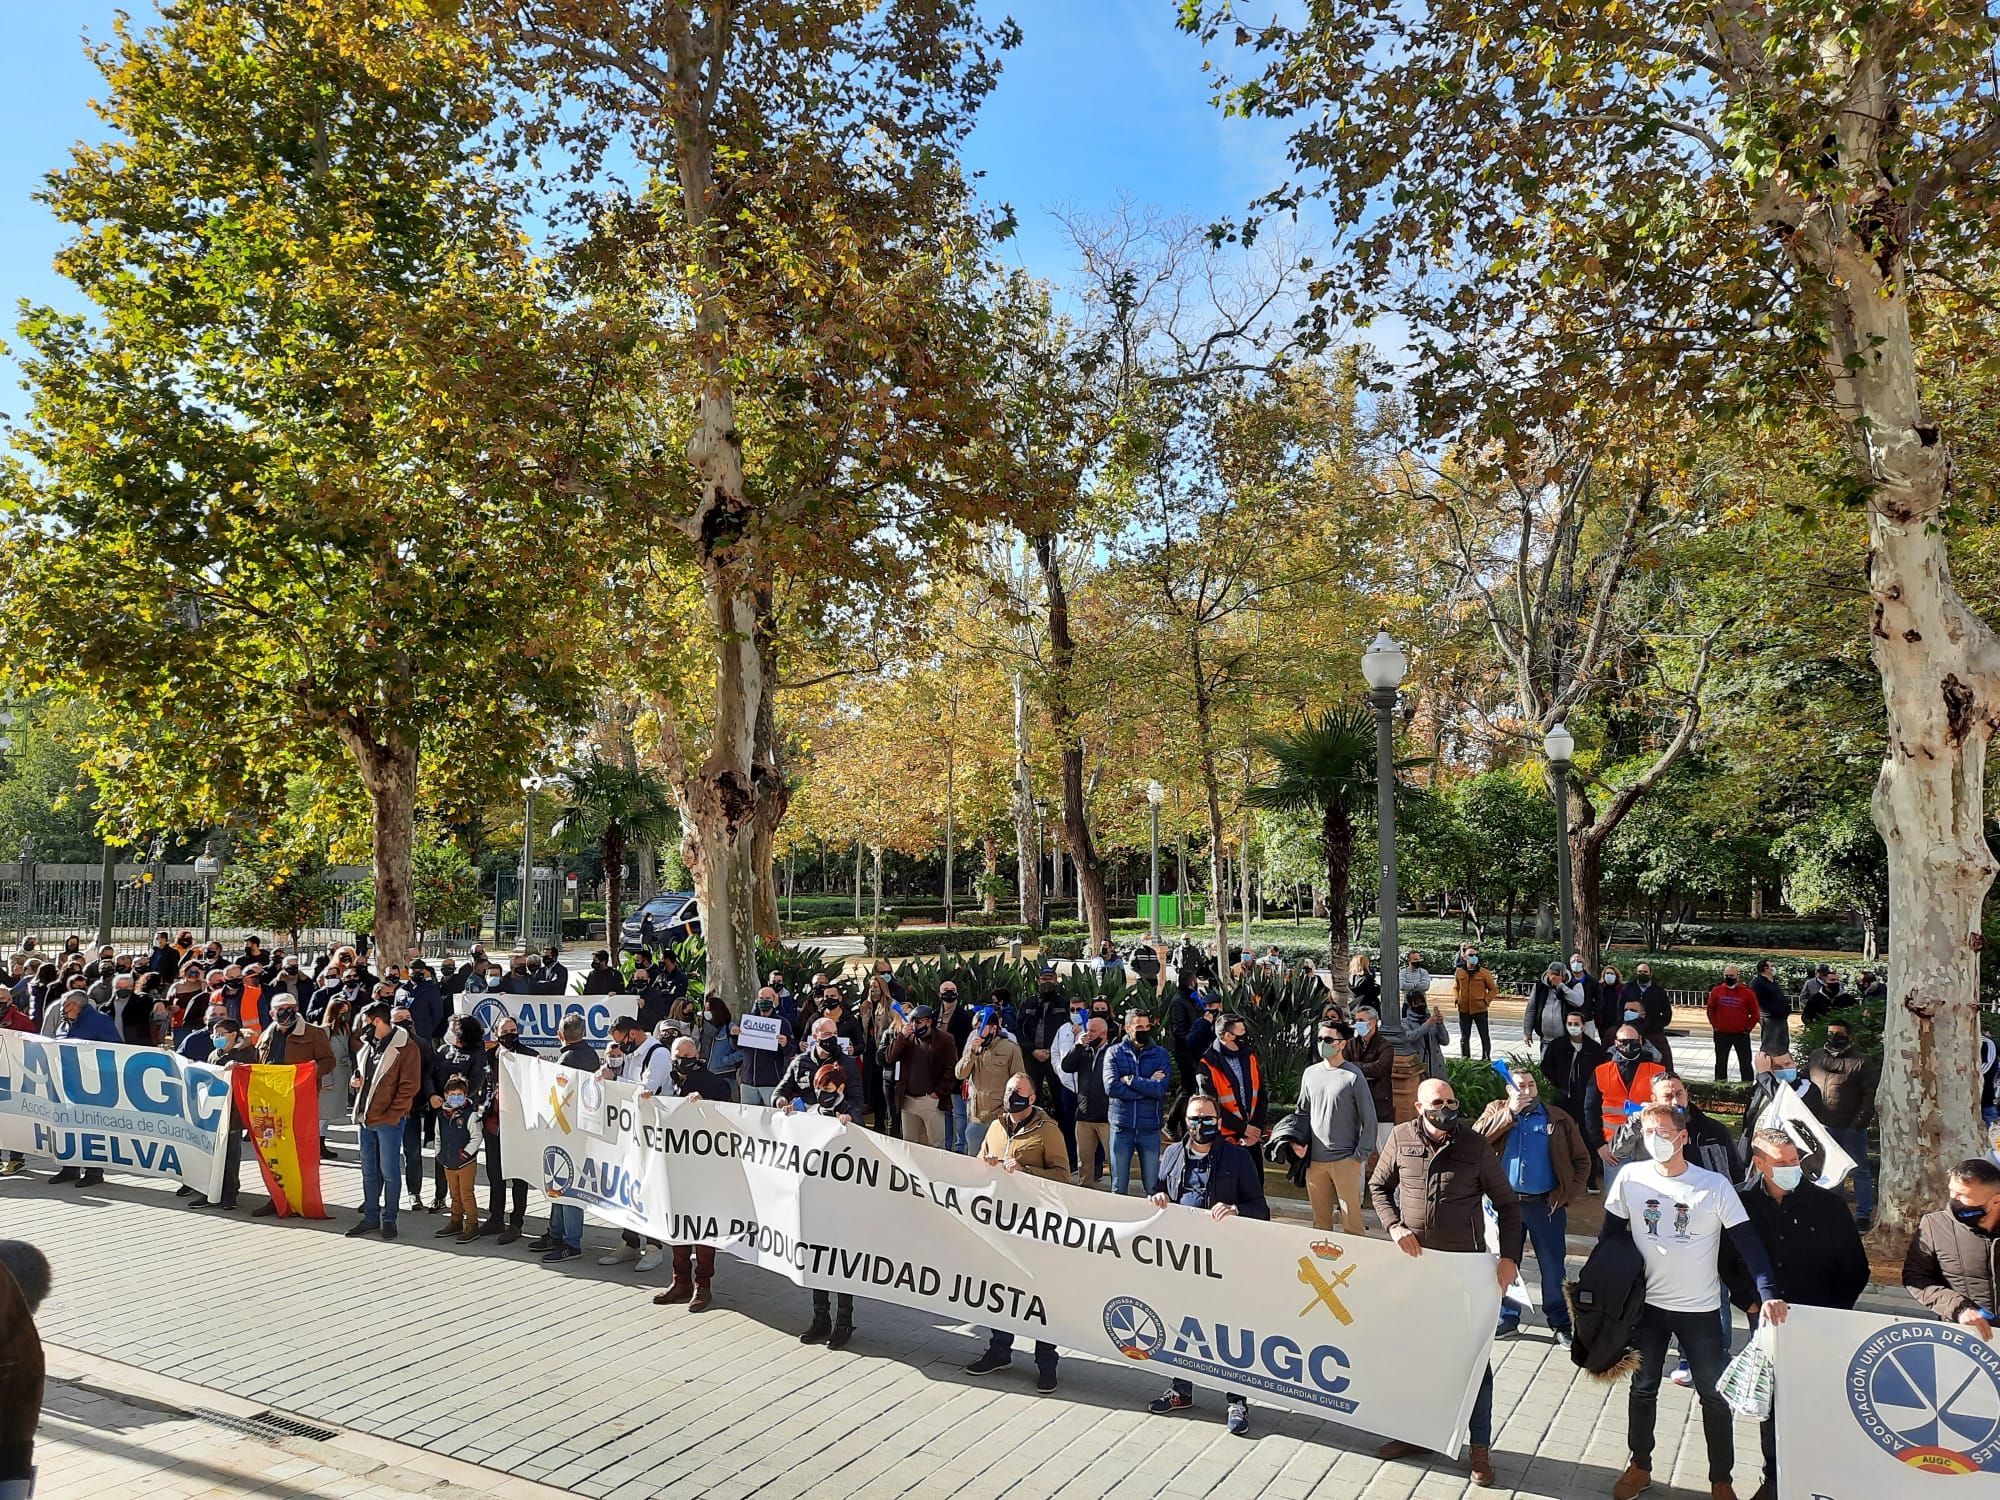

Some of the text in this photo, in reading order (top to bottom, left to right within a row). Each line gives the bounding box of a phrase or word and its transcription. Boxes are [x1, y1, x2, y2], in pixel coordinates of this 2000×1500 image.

[752, 1020, 776, 1031] AUGC
[21, 1040, 230, 1132] AUGC
[74, 1109, 134, 1131] Unificada
[137, 1119, 154, 1134] de
[33, 1122, 183, 1177] HUELVA
[577, 1157, 644, 1214] AUGC
[642, 1124, 880, 1188] DEMOCRATIZACIÓN
[889, 1165, 925, 1199] DE
[929, 1181, 963, 1216] LA
[970, 1195, 1122, 1259] GUARDIA
[1131, 1235, 1223, 1280] CIVIL
[665, 1212, 1048, 1326] UNA PRODUCTIVIDAD JUSTA
[1170, 1315, 1351, 1394] AUGC
[1860, 1327, 1935, 1366] UNIFICADA
[1941, 1330, 1966, 1346] DE
[1172, 1356, 1351, 1411] ASOCIACIÓN UNIFICADA DE GUARDIAS CIVILES
[1850, 1367, 1905, 1452] ASOCIACIÓN
[1922, 1455, 1952, 1467] AUGC
